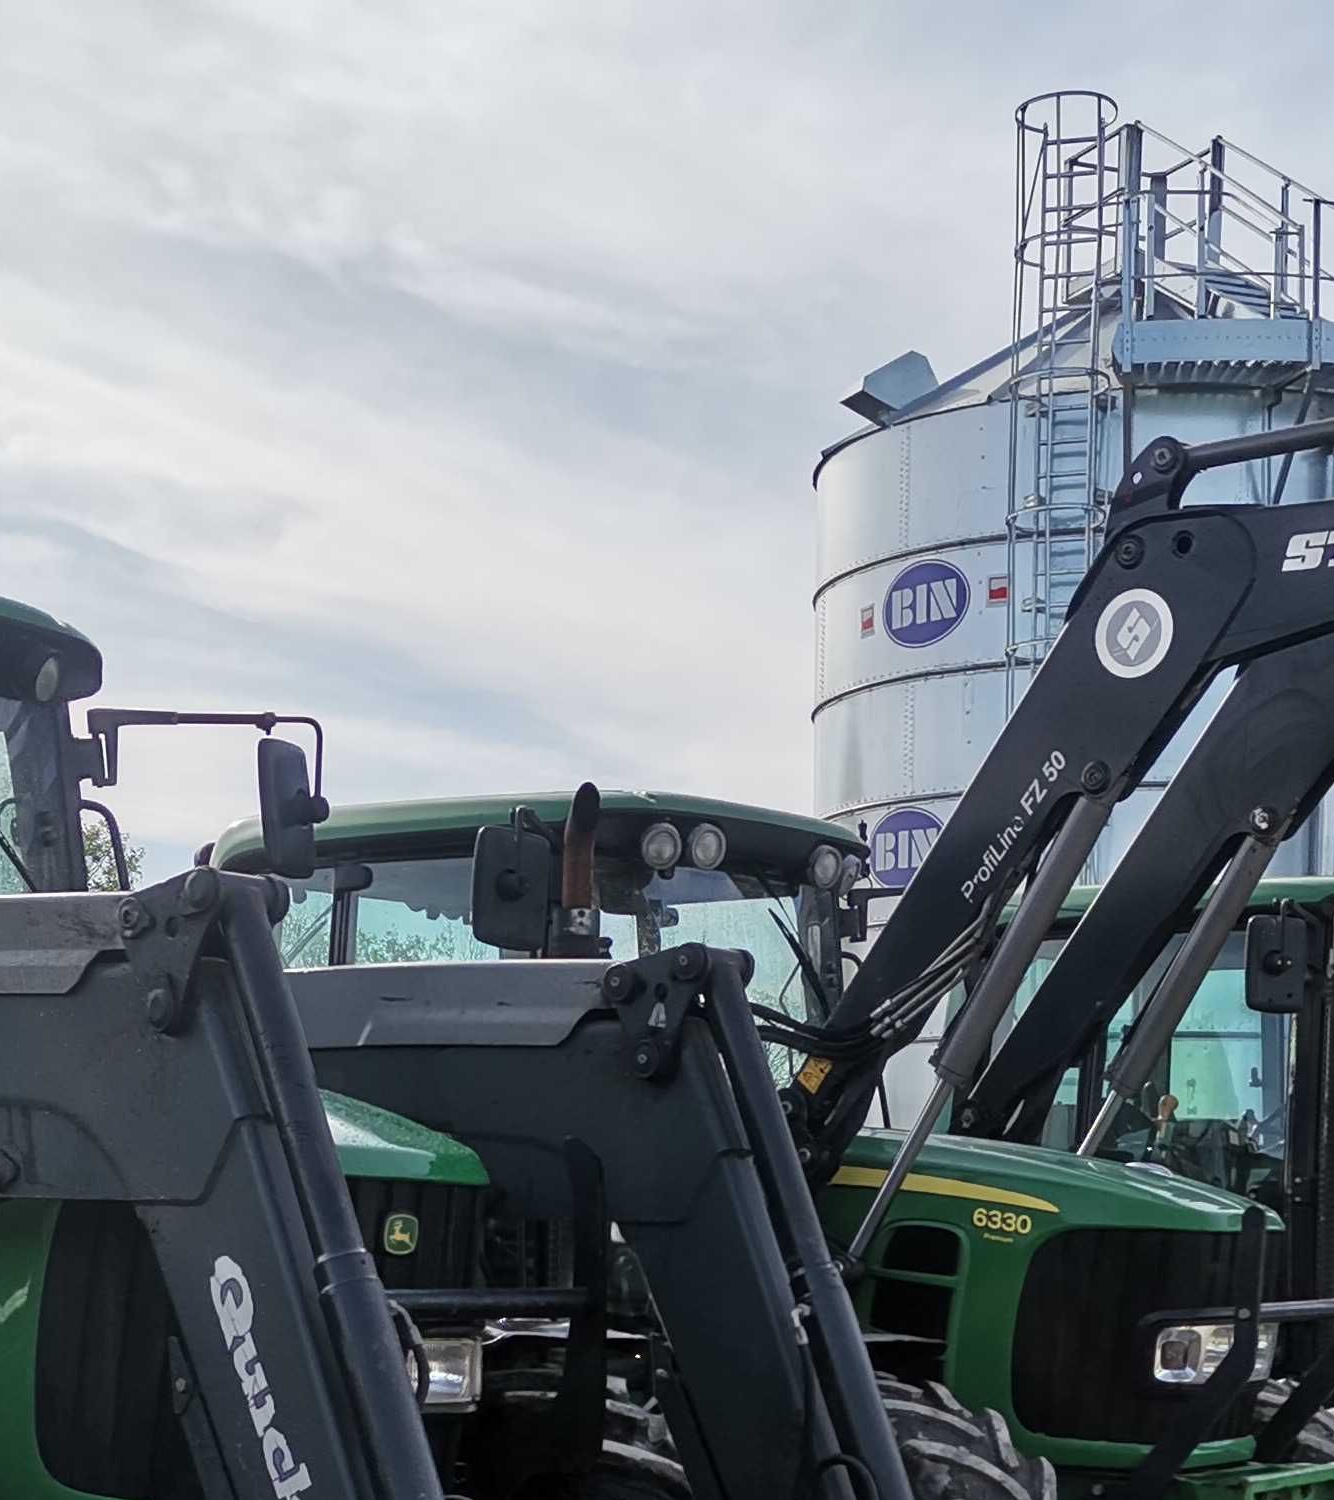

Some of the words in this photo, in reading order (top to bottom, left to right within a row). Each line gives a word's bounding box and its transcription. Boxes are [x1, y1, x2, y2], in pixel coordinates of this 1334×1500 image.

[891, 577, 958, 631] BIN
[1020, 778, 1049, 817] FZ
[1042, 750, 1067, 783] 50
[875, 827, 938, 873] BIN
[972, 1208, 1033, 1235] 6330
